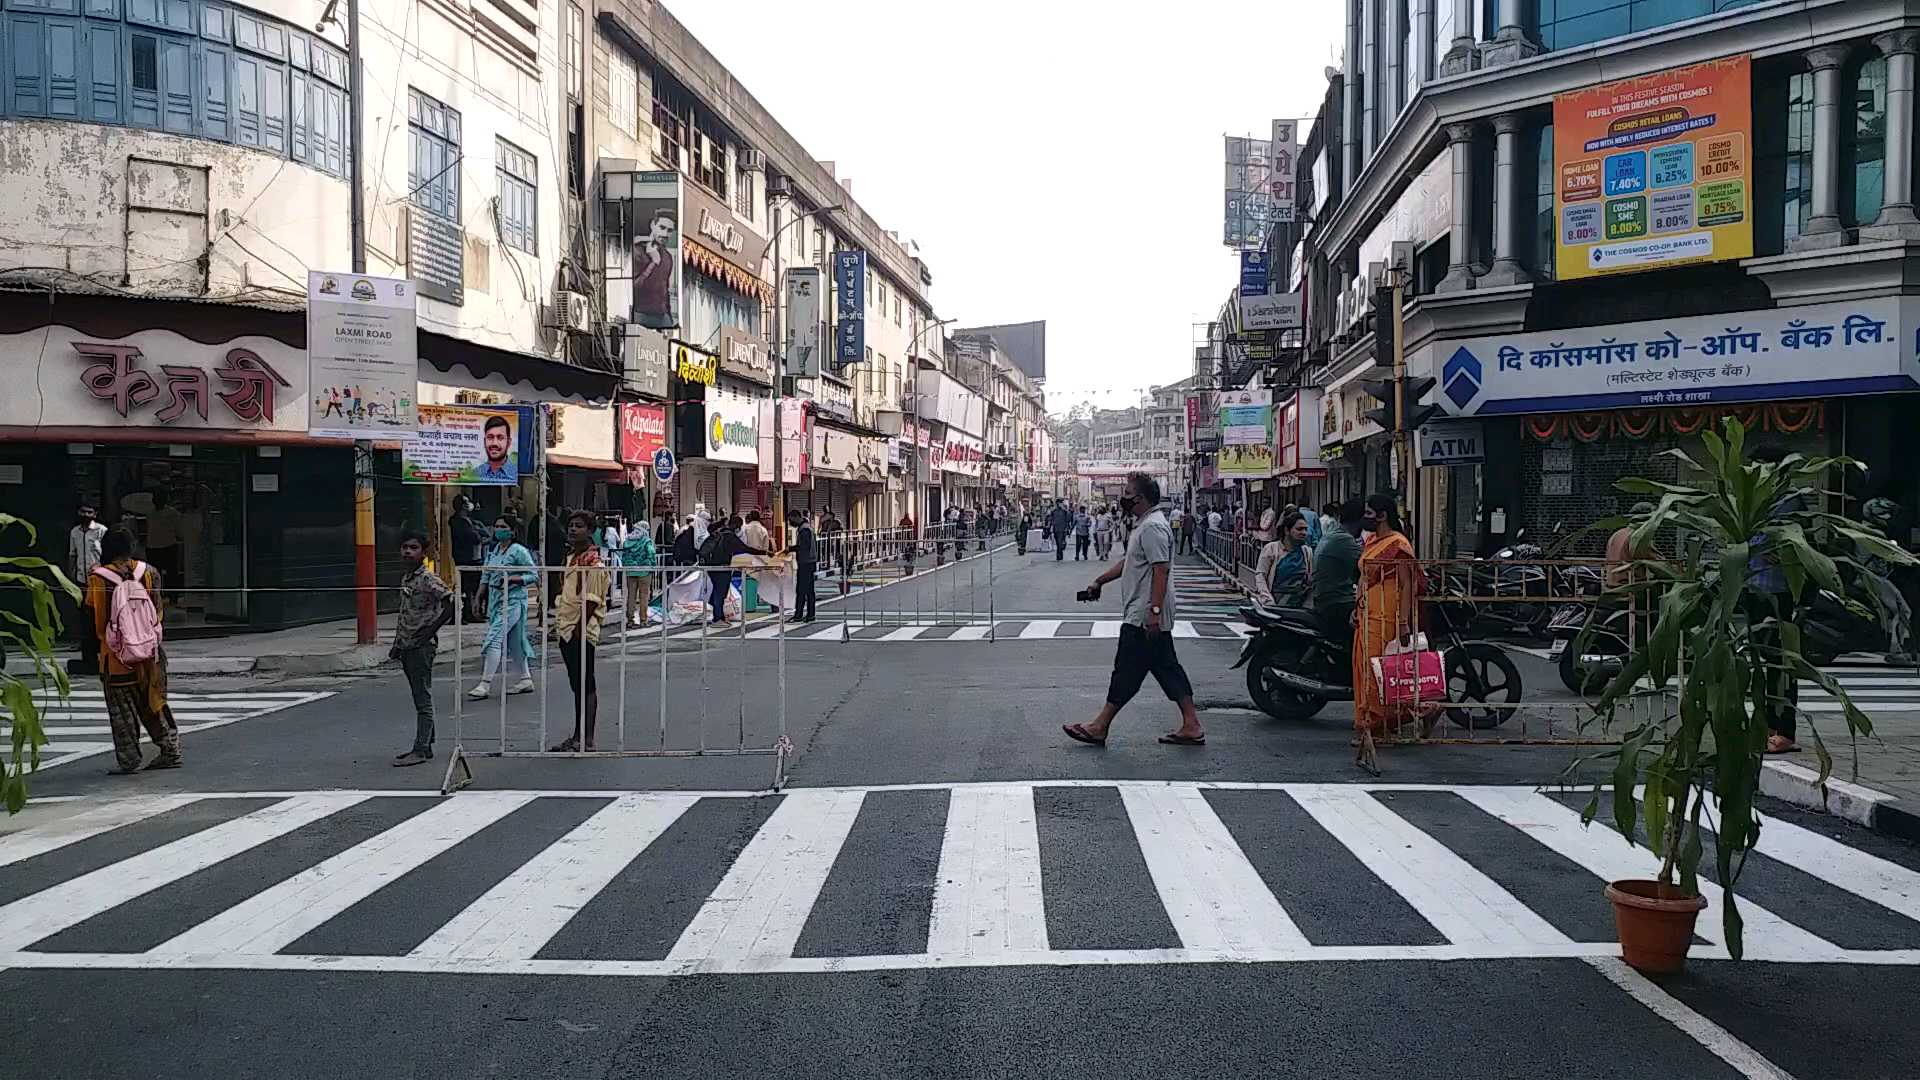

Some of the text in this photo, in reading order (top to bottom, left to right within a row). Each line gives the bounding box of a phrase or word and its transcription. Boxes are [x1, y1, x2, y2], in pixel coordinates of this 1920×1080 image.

[1620, 93, 1633, 102] THIS
[1635, 89, 1658, 99] FESTIVE
[1660, 83, 1684, 95] SEASON
[1587, 108, 1611, 118] FULFILL
[1613, 103, 1630, 113] YOUR
[1631, 99, 1659, 110] DREAMS
[1661, 94, 1677, 103] WITH
[1679, 88, 1707, 100] COSMOS
[1614, 111, 1682, 131] COSMOS RETAIL LOANS
[1615, 135, 1633, 145] NEWLY
[1635, 128, 1660, 140] REDUCED
[1661, 122, 1688, 135] INTEREST
[1690, 118, 1708, 129] RATES
[1709, 141, 1731, 150] COSMO
[1709, 148, 1731, 158] CREDIT
[1563, 162, 1600, 175] HOME LOAN
[1618, 159, 1632, 167] CAR
[1701, 161, 1739, 176] 10.00%
[1616, 168, 1635, 177] LOAN
[1656, 169, 1687, 183] 8.25%
[1567, 174, 1595, 188] 6.70%
[1610, 177, 1641, 191] 7.40%
[1613, 201, 1638, 212] COSMO
[1704, 201, 1736, 215] 8.75%
[1618, 212, 1634, 221] SME
[1656, 215, 1688, 228] 8.00%
[1568, 228, 1597, 240] 8.00%
[1611, 222, 1641, 235] 8.00%
[1619, 247, 1648, 255] COSMOS
[1673, 239, 1693, 248] BANK
[843, 254, 859, 267] पुणे
[335, 327, 392, 339] LAXMI ROAD
[1498, 314, 1895, 372] दि कॉसमॉस को-ऑप. बँक लि.
[1606, 369, 1664, 386] (मल्टिस्टेट
[1666, 391, 1683, 402] रोड
[1685, 391, 1711, 401] शाखा
[624, 408, 664, 440] Kalpalata
[1430, 438, 1475, 456] ATM
